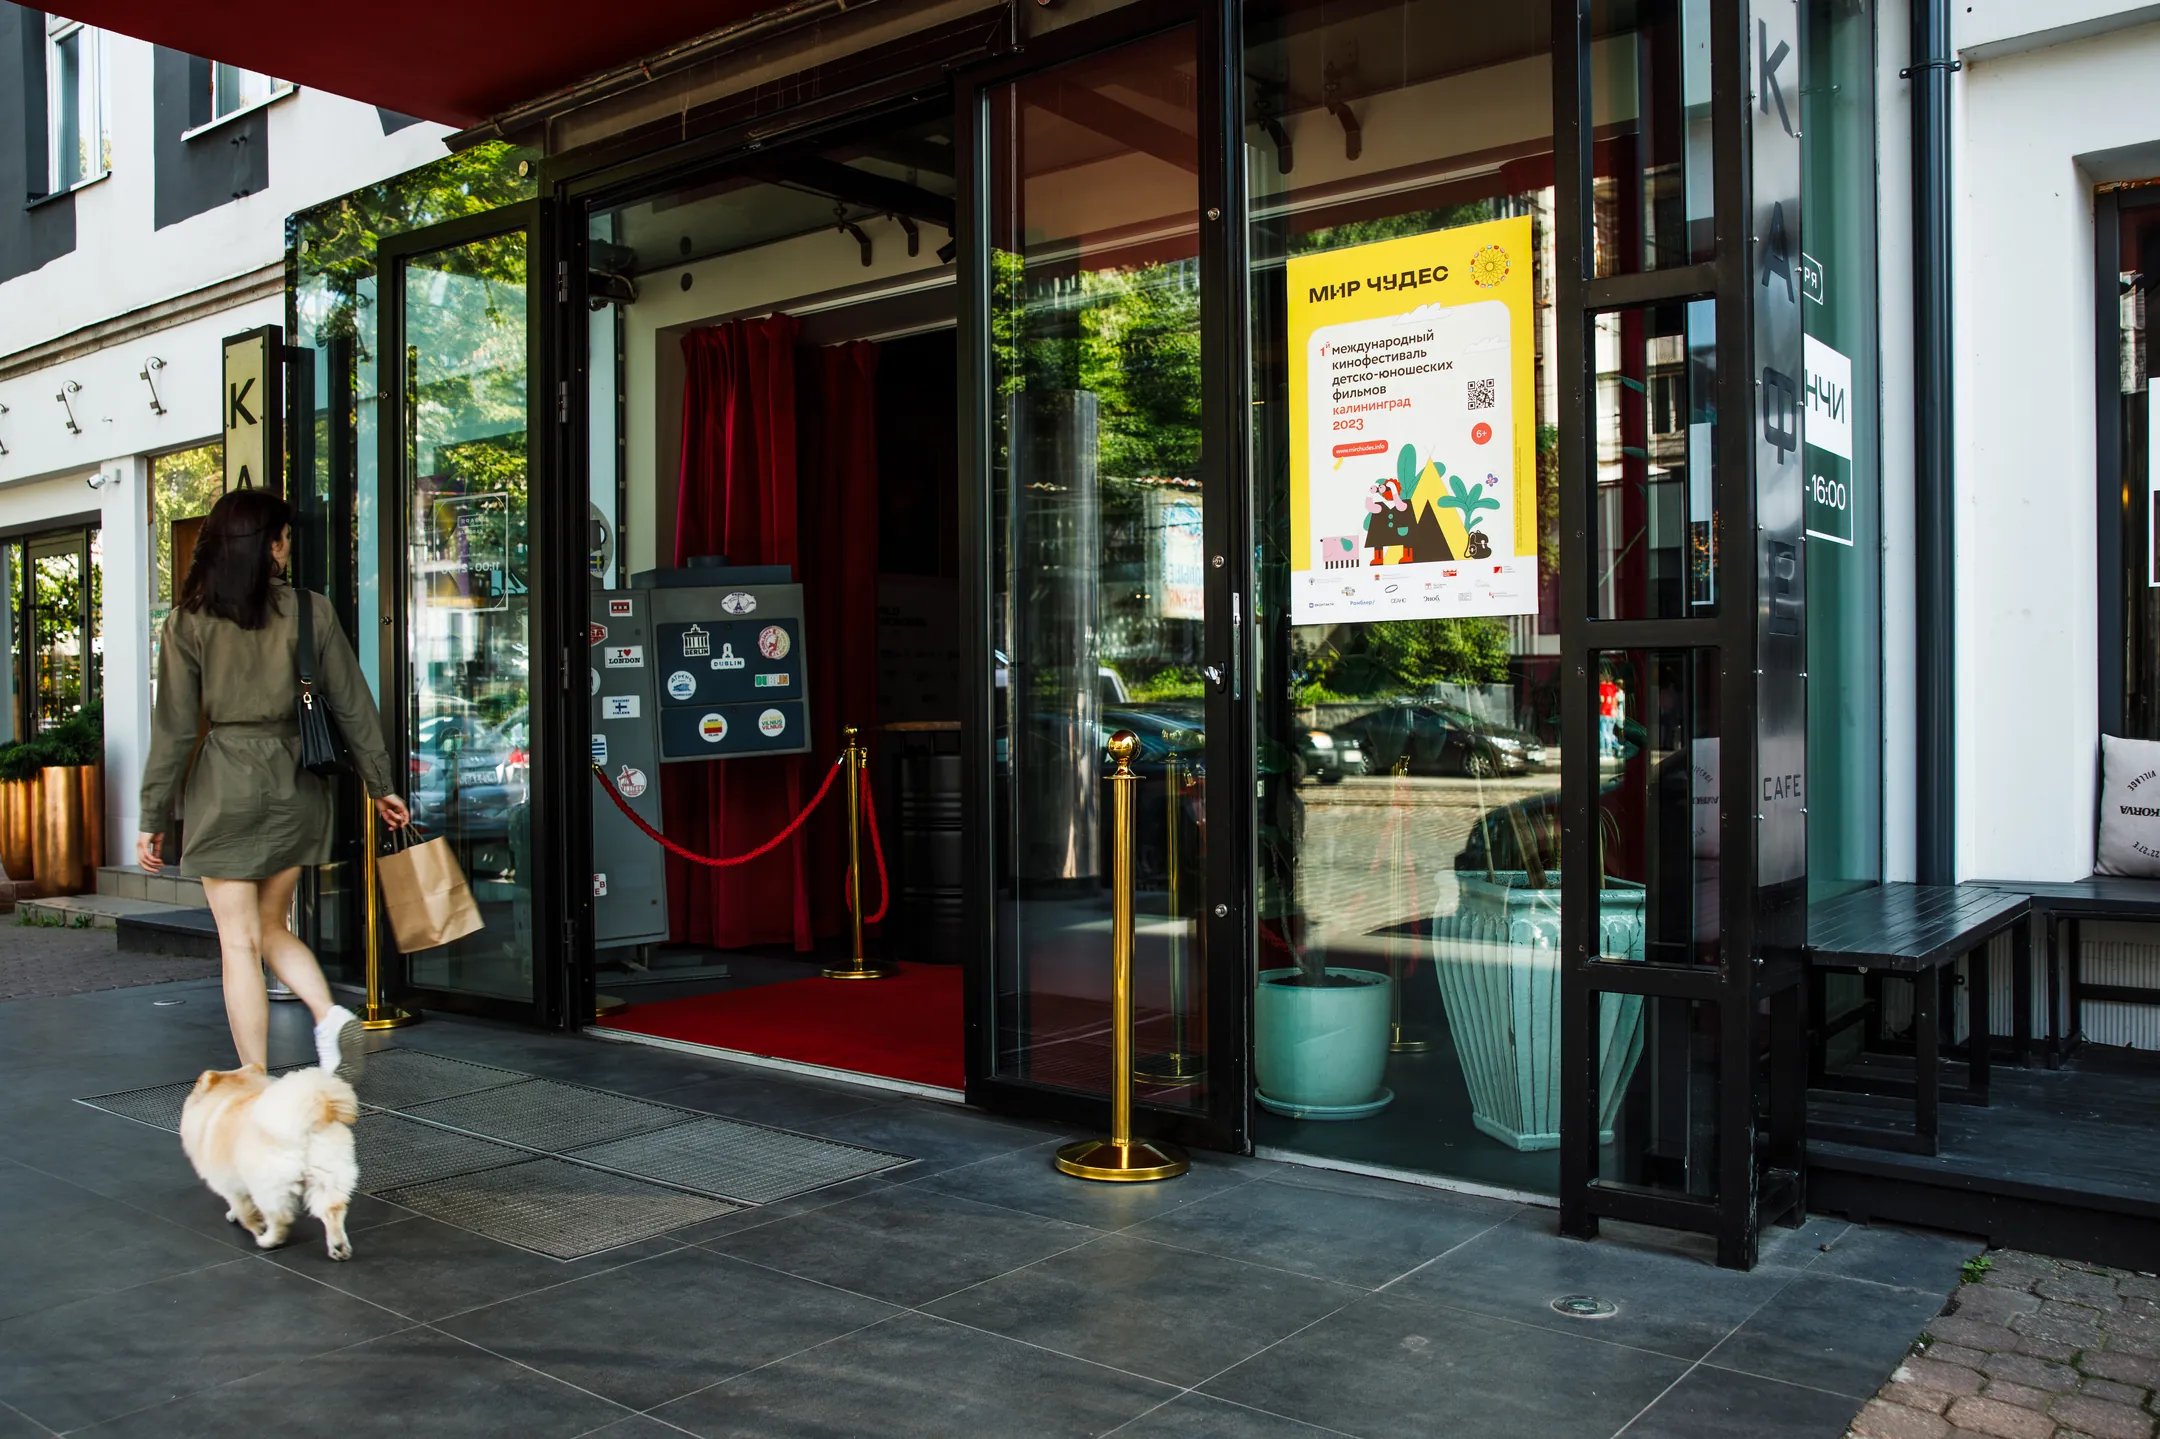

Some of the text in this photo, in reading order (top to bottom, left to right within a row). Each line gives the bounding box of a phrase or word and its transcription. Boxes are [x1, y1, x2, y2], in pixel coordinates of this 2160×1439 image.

[1309, 265, 1449, 304] МИР ЧУДЕС
[1331, 329, 1435, 356] международный
[1331, 349, 1428, 371] кинофестиваль
[1331, 360, 1454, 388] детско-юношеских
[1332, 385, 1388, 404] фильмов
[1332, 397, 1412, 416] калининград
[1332, 418, 1364, 431] 2023
[1475, 429, 1488, 439] 6+
[1811, 474, 1846, 511] 16:00
[608, 657, 641, 665] LONDON
[685, 648, 709, 656] BERLIN
[755, 674, 789, 686] DUBLIN
[1763, 774, 1802, 802] CAFE
[2127, 769, 2157, 792] VILLAGE
